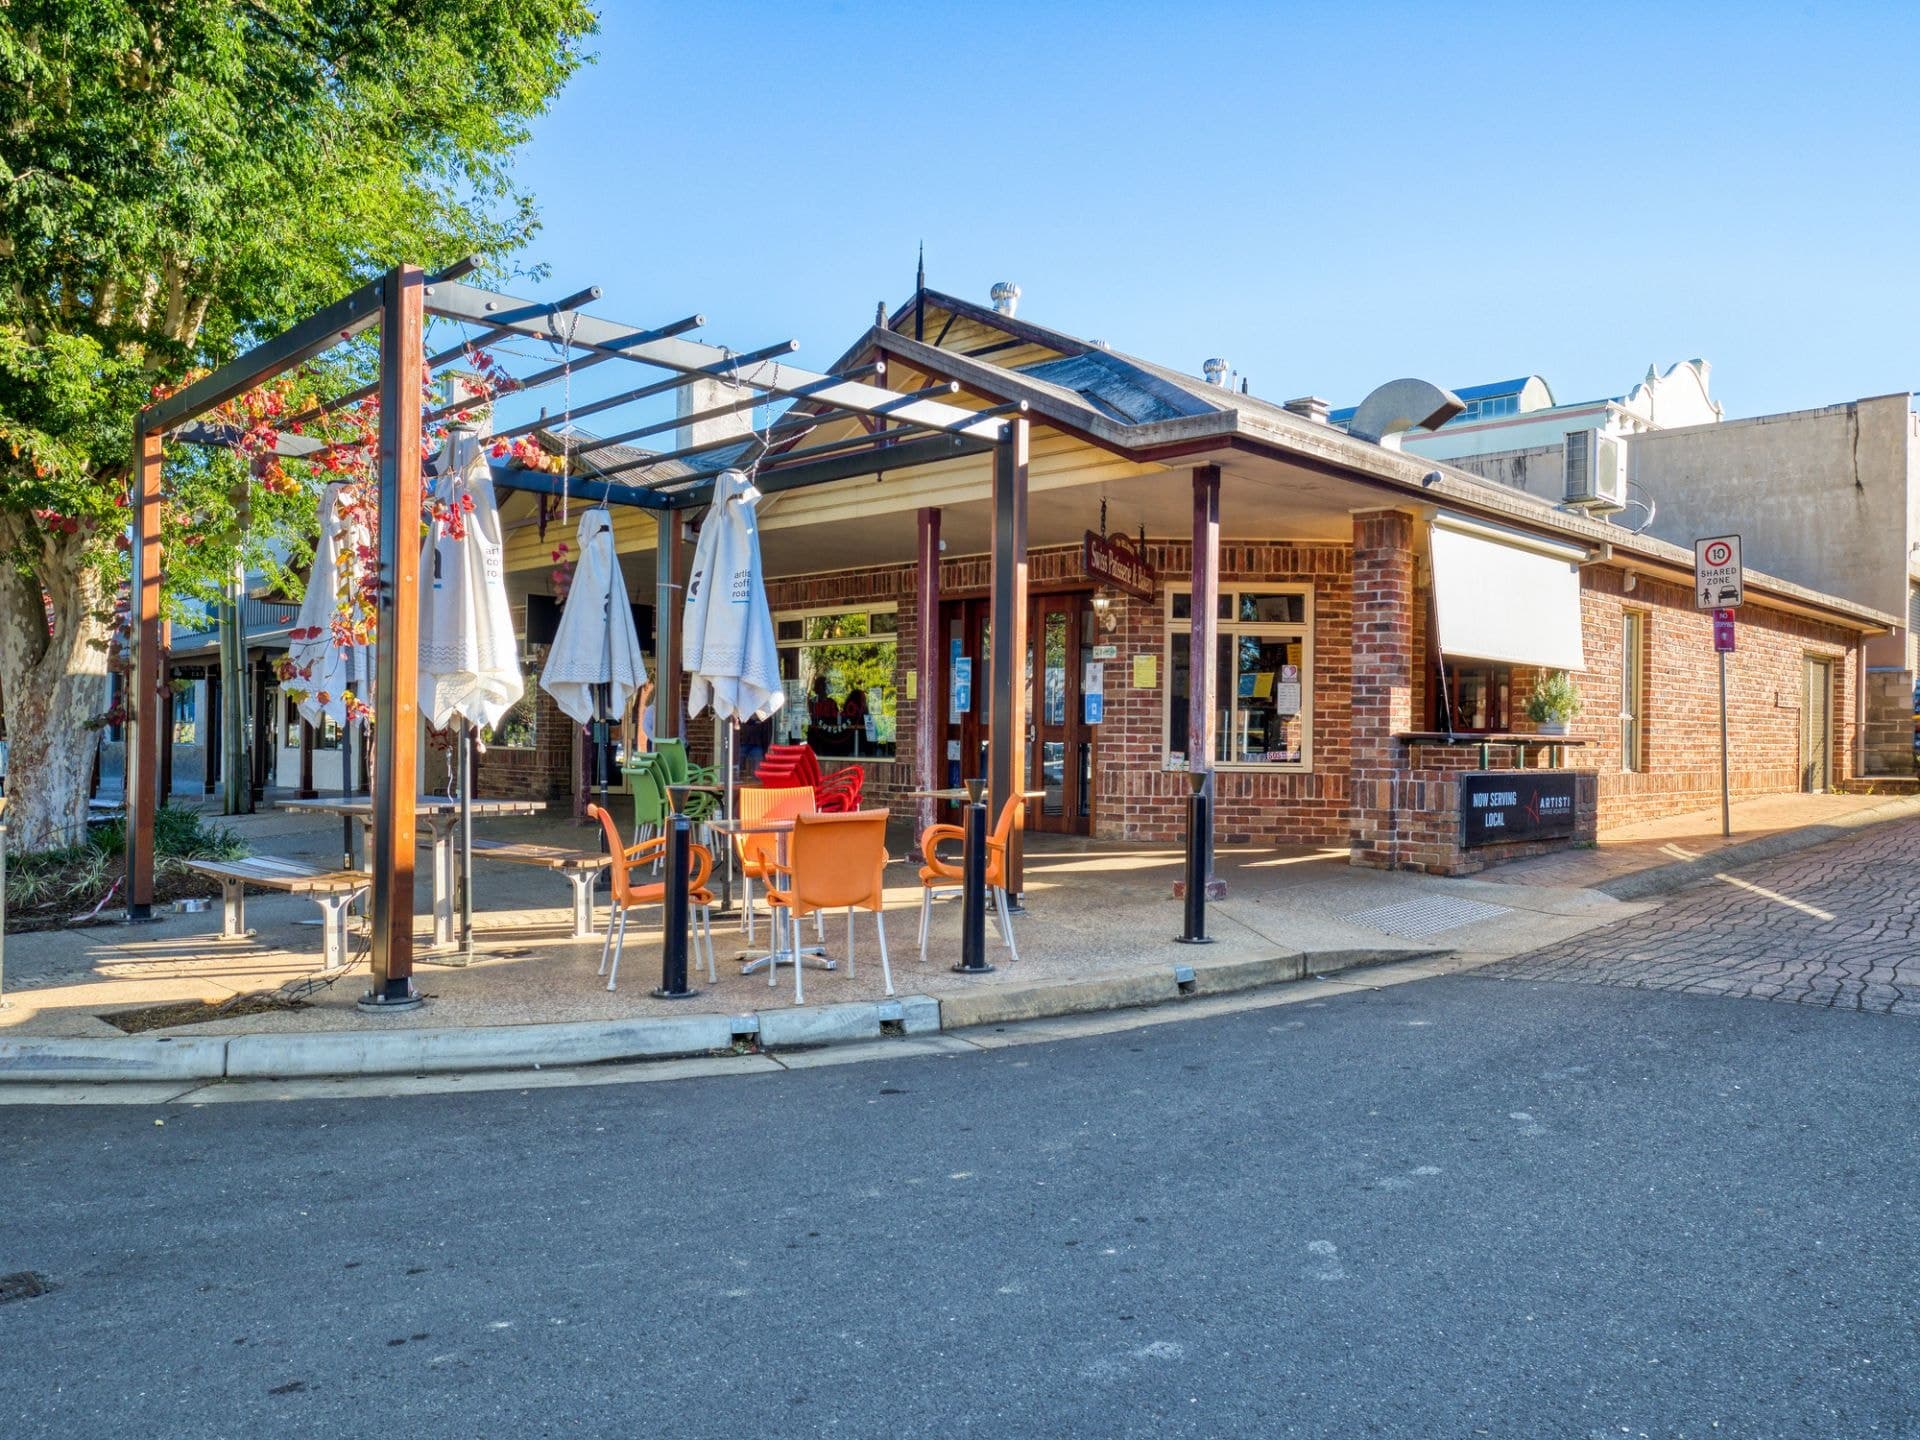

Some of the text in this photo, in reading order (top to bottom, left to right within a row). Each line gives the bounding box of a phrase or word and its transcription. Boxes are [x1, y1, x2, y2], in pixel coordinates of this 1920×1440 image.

[1712, 548, 1725, 560] 10
[1701, 567, 1737, 578] SHARED
[1706, 576, 1731, 586] ZONE
[1473, 791, 1517, 808] NOW SERVING
[1540, 796, 1570, 809] ARTISTI
[1485, 812, 1505, 828] LOCAL
